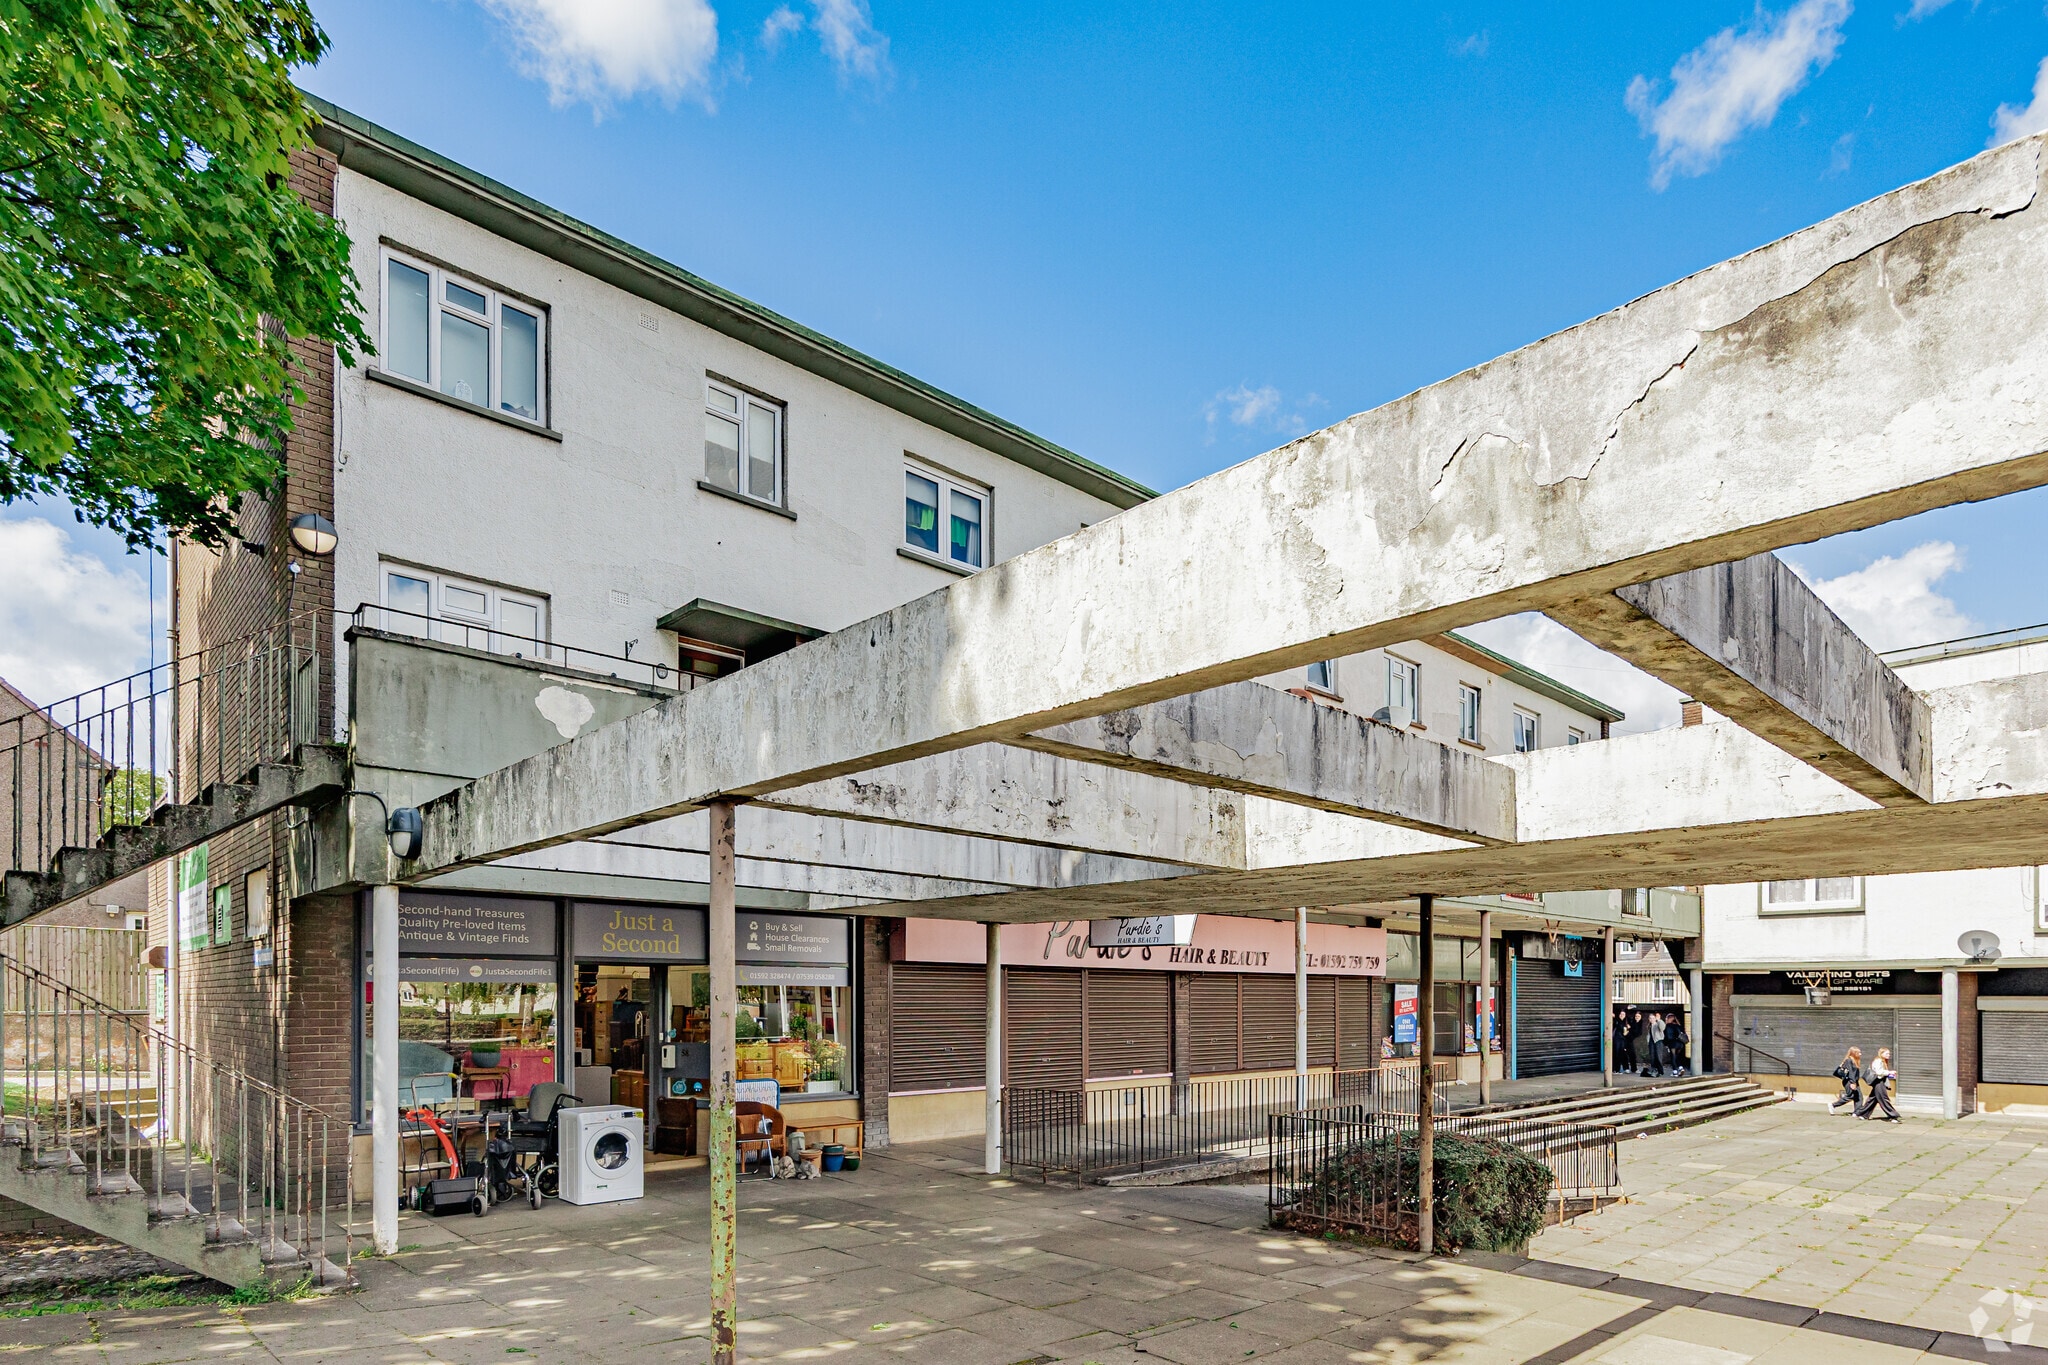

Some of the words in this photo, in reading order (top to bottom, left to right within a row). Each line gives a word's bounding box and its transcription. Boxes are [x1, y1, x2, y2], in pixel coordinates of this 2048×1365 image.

[399, 904, 472, 917] Second-hand
[474, 907, 525, 919] Treasures
[399, 917, 439, 930] Quality
[442, 919, 494, 930] Pre-loved
[497, 921, 526, 931] Items
[609, 910, 656, 931] Just
[662, 918, 674, 932] a
[765, 923, 780, 932] Buy
[781, 923, 788, 931] &
[789, 924, 803, 932] Sell
[399, 930, 443, 942] Antique
[446, 931, 455, 941] &
[458, 932, 499, 944] Vintage
[502, 934, 529, 943] Finds
[602, 932, 681, 954] Second
[765, 933, 789, 942] House
[791, 934, 829, 944] Clearances
[765, 943, 786, 952] Small
[787, 944, 822, 953] Removals
[1168, 946, 1204, 964] HAIR
[1207, 948, 1216, 965] &
[1220, 950, 1270, 967] BEAUTY
[1365, 956, 1380, 969] 759
[1855, 970, 1890, 978] GIFTS
